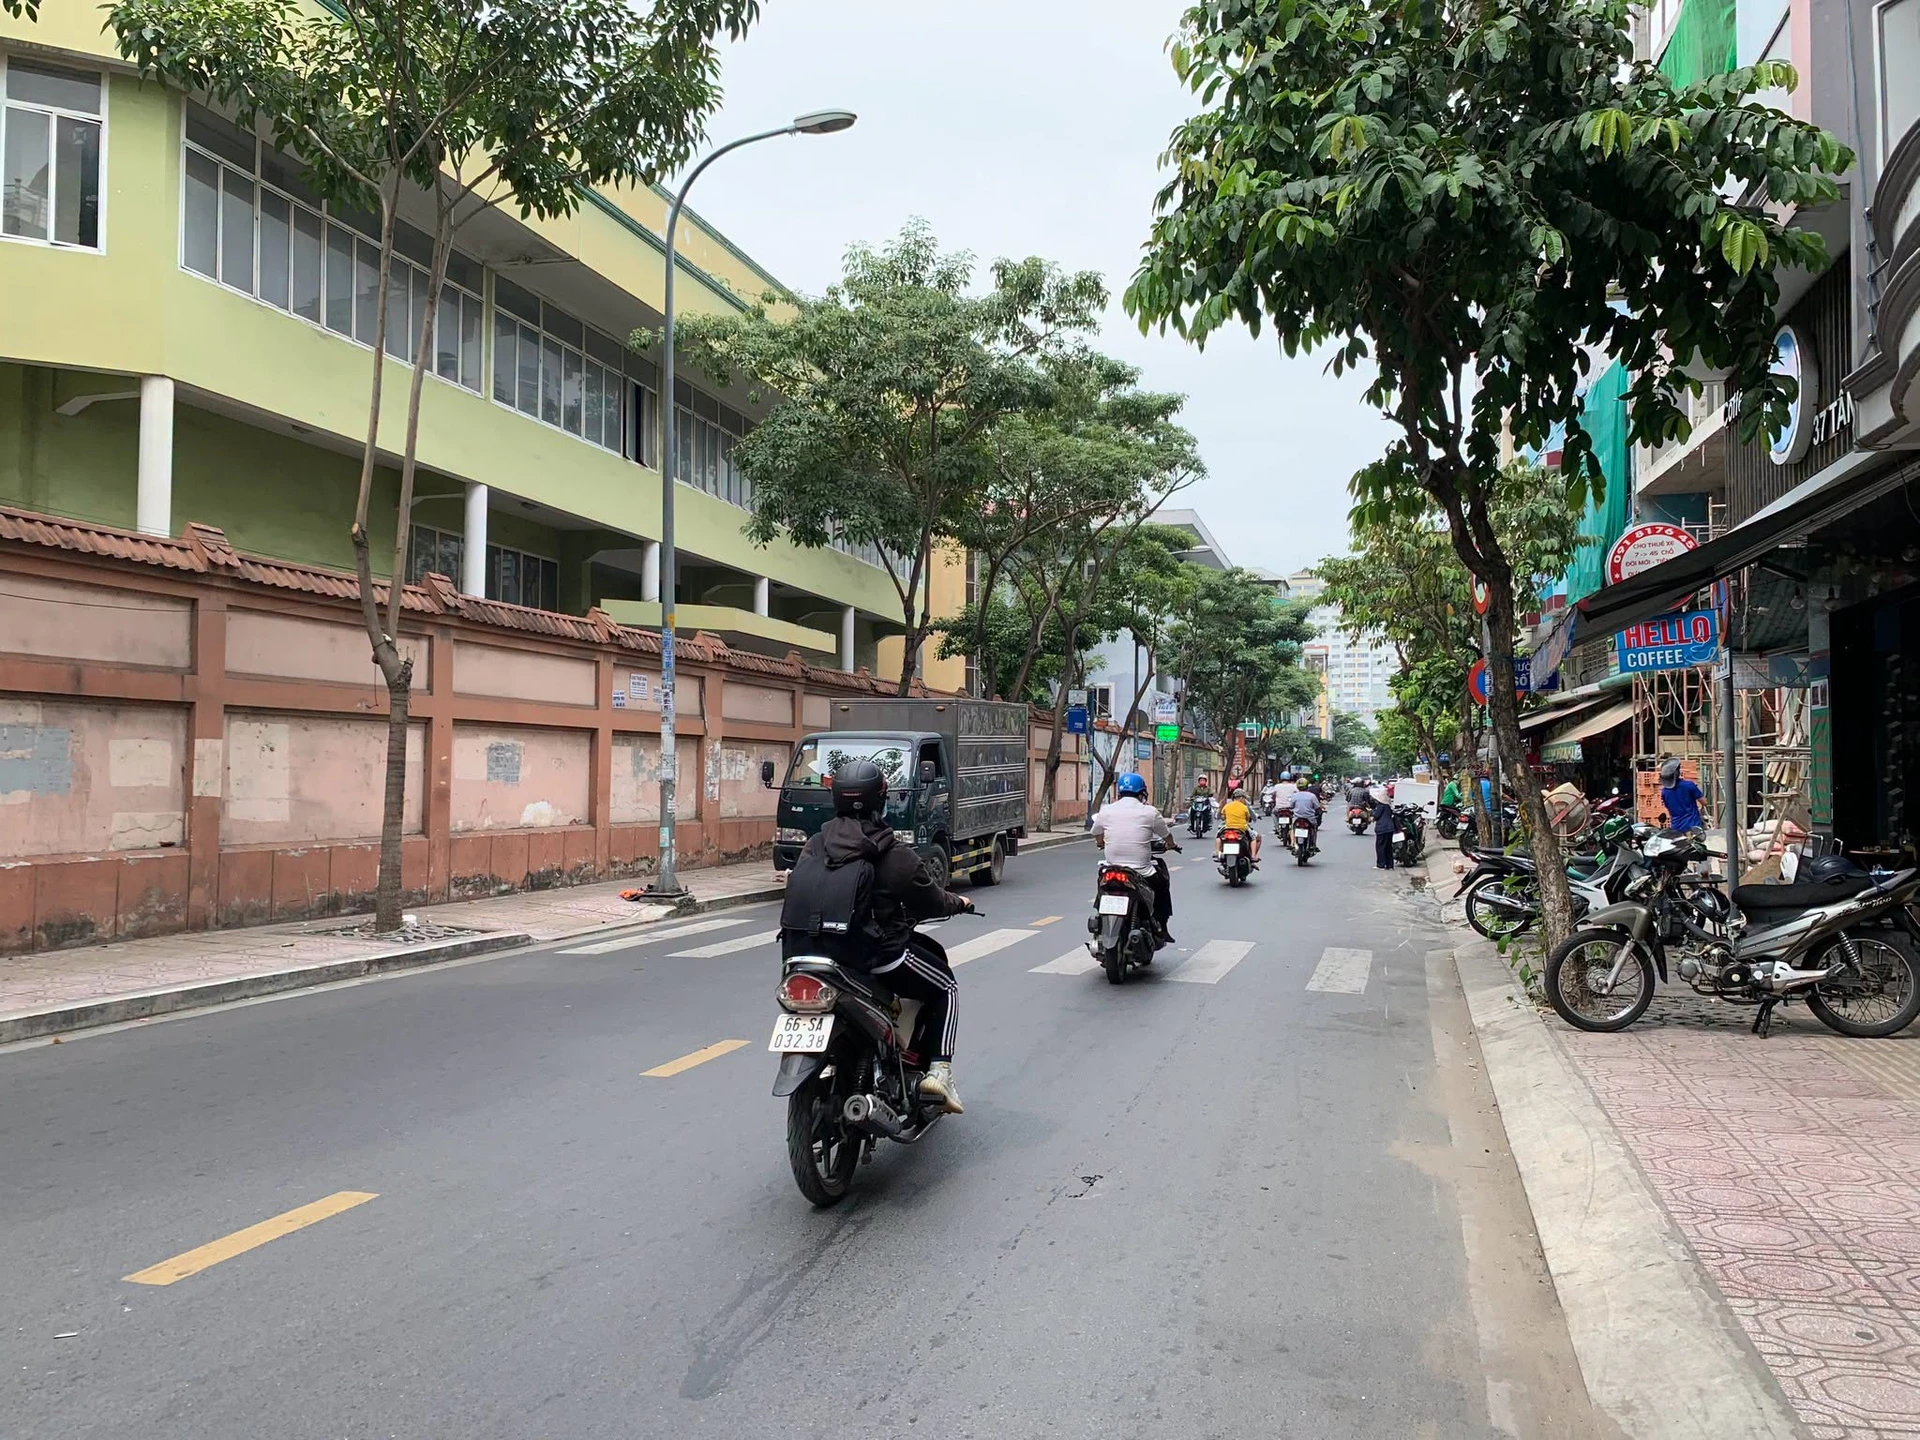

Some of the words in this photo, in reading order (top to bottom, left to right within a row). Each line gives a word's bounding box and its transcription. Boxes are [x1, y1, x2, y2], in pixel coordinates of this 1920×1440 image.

[1813, 410, 1827, 446] 37
[1828, 388, 1854, 434] TÂN
[1613, 540, 1632, 564] 091
[1634, 526, 1674, 539] 8176
[1624, 616, 1711, 649] HELLO
[1627, 649, 1684, 668] COFFEE
[784, 1017, 824, 1032] 66-SA
[774, 1033, 825, 1048] 032.38
